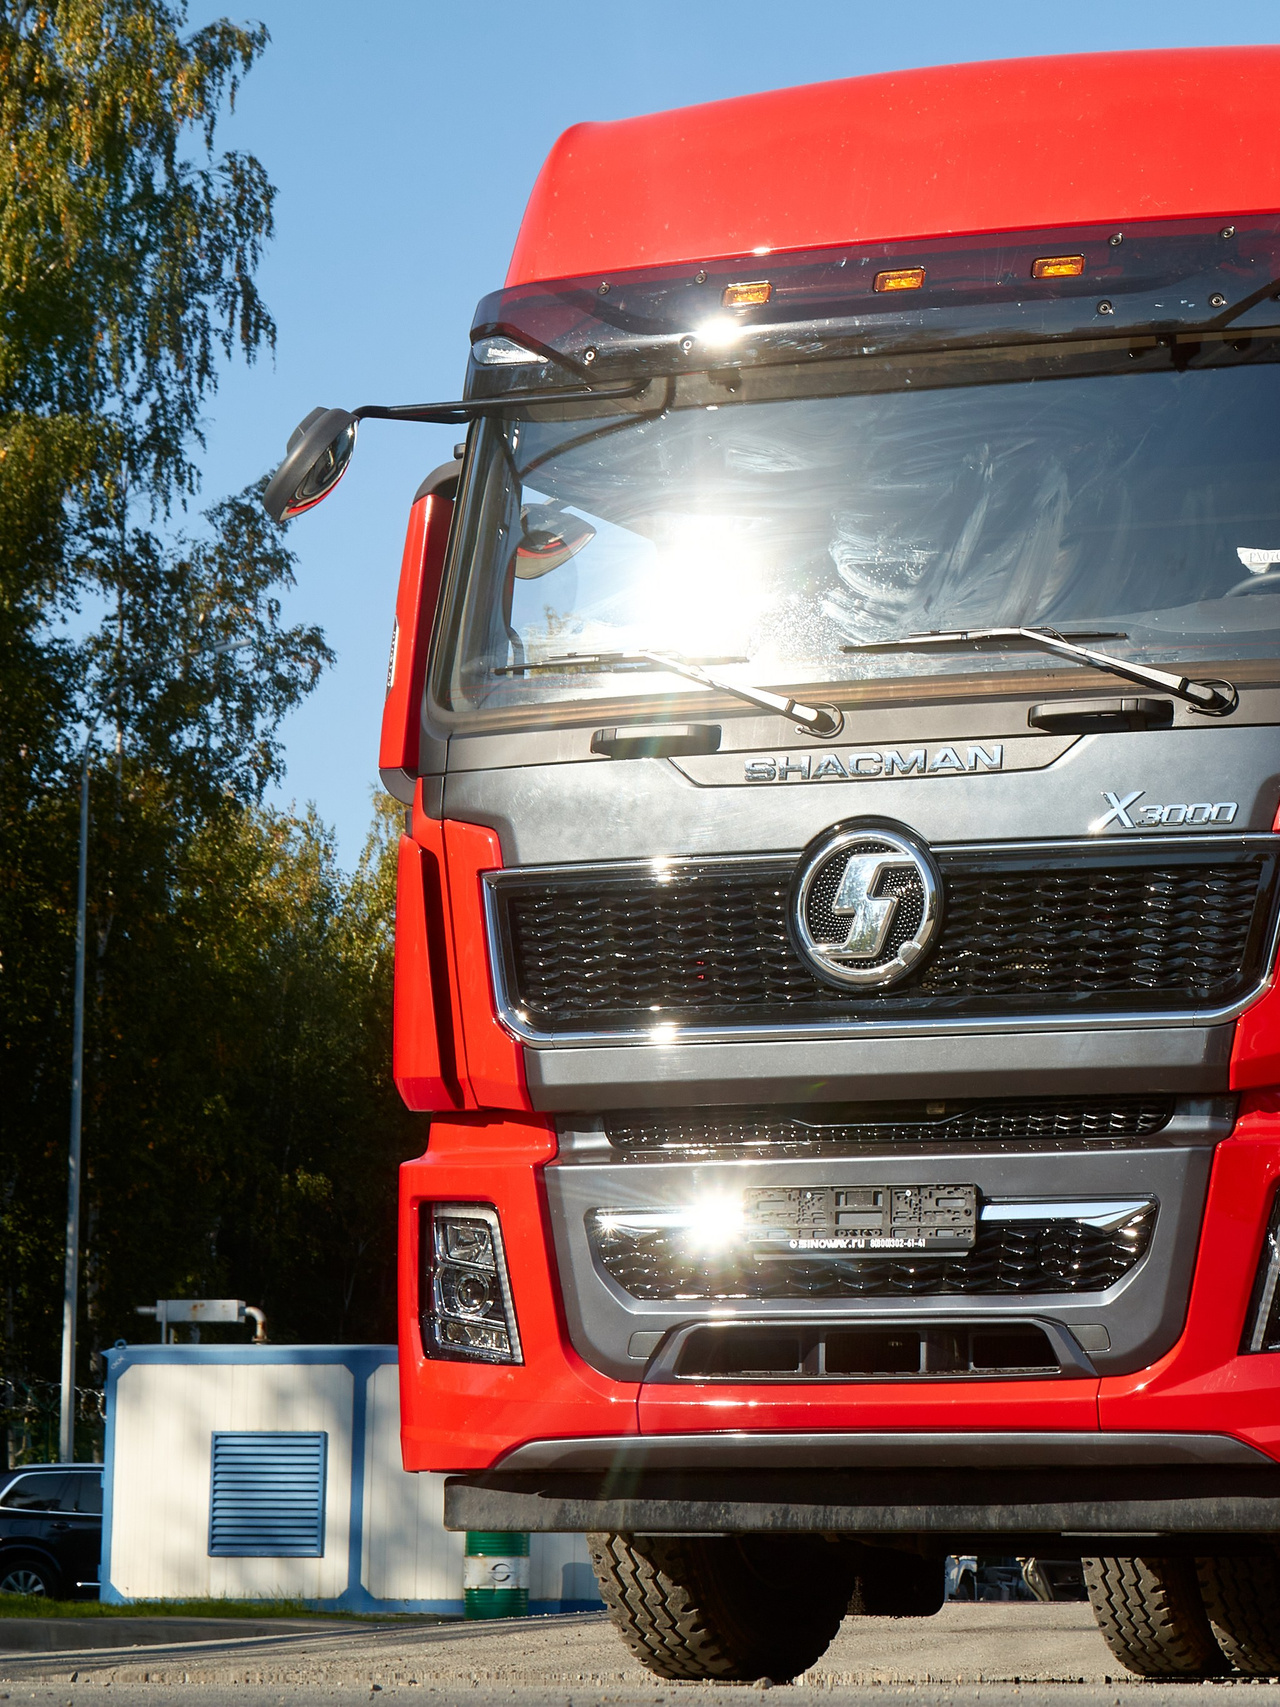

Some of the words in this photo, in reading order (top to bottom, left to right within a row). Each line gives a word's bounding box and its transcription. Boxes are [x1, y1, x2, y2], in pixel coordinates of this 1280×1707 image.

[743, 745, 1004, 782] SHACMAN
[1093, 791, 1238, 830] X3000
[798, 1239, 865, 1249] SINOWAY.ru
